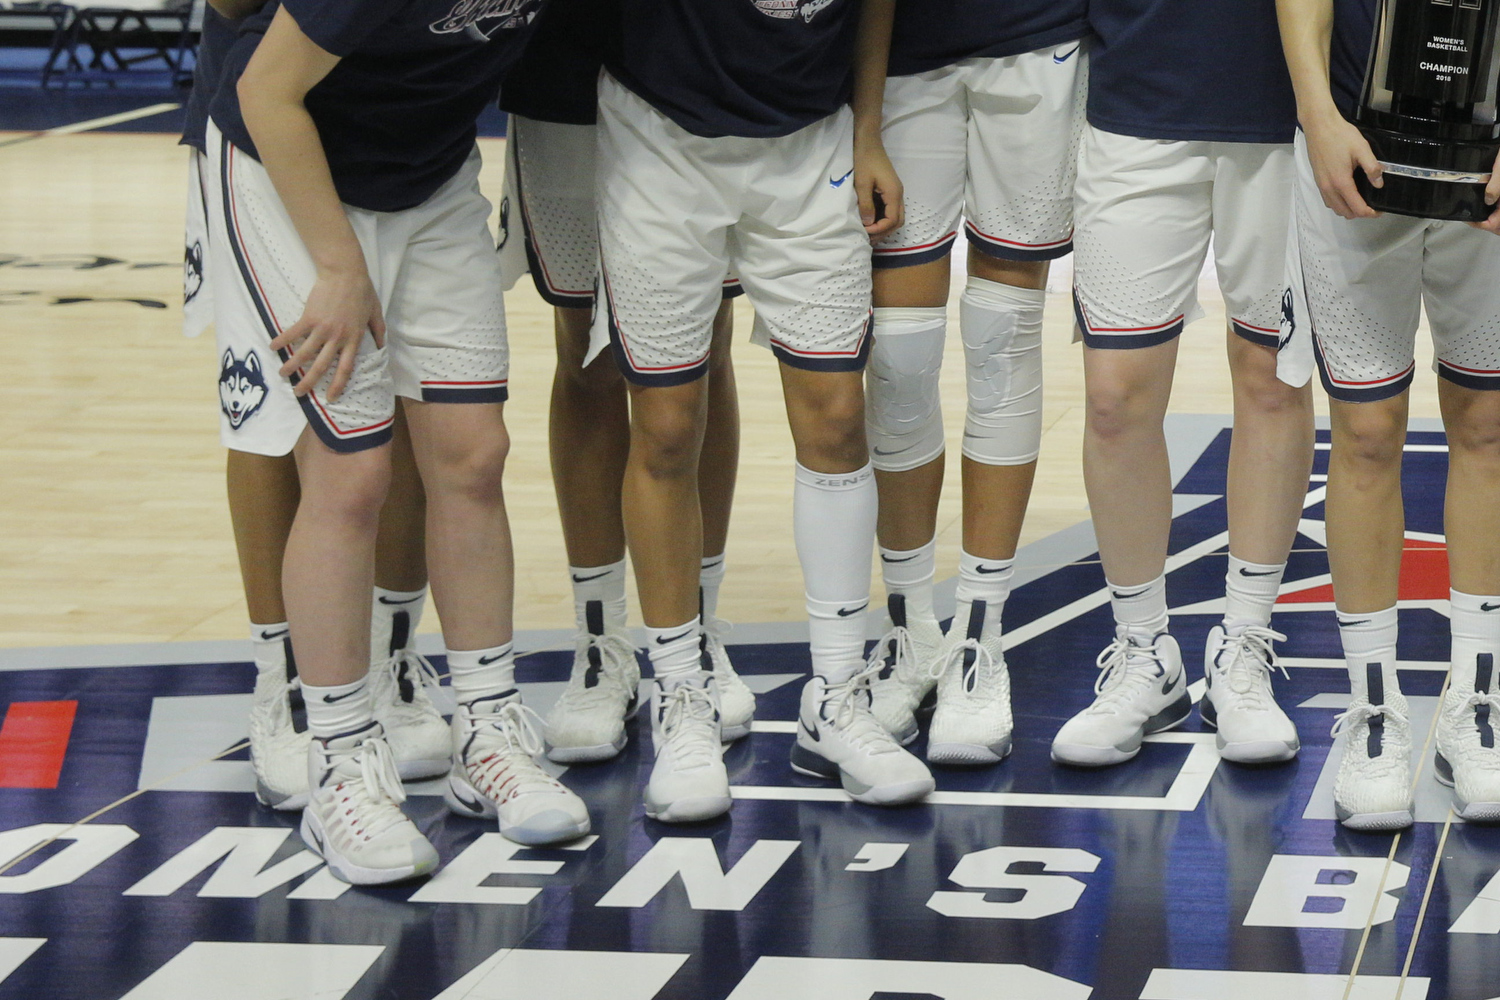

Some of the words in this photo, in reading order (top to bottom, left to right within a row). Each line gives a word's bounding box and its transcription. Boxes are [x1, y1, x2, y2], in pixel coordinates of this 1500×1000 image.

[1433, 36, 1464, 45] WOMEN'S
[1427, 41, 1468, 53] BASKETBALL
[1419, 61, 1469, 75] CHAMPION
